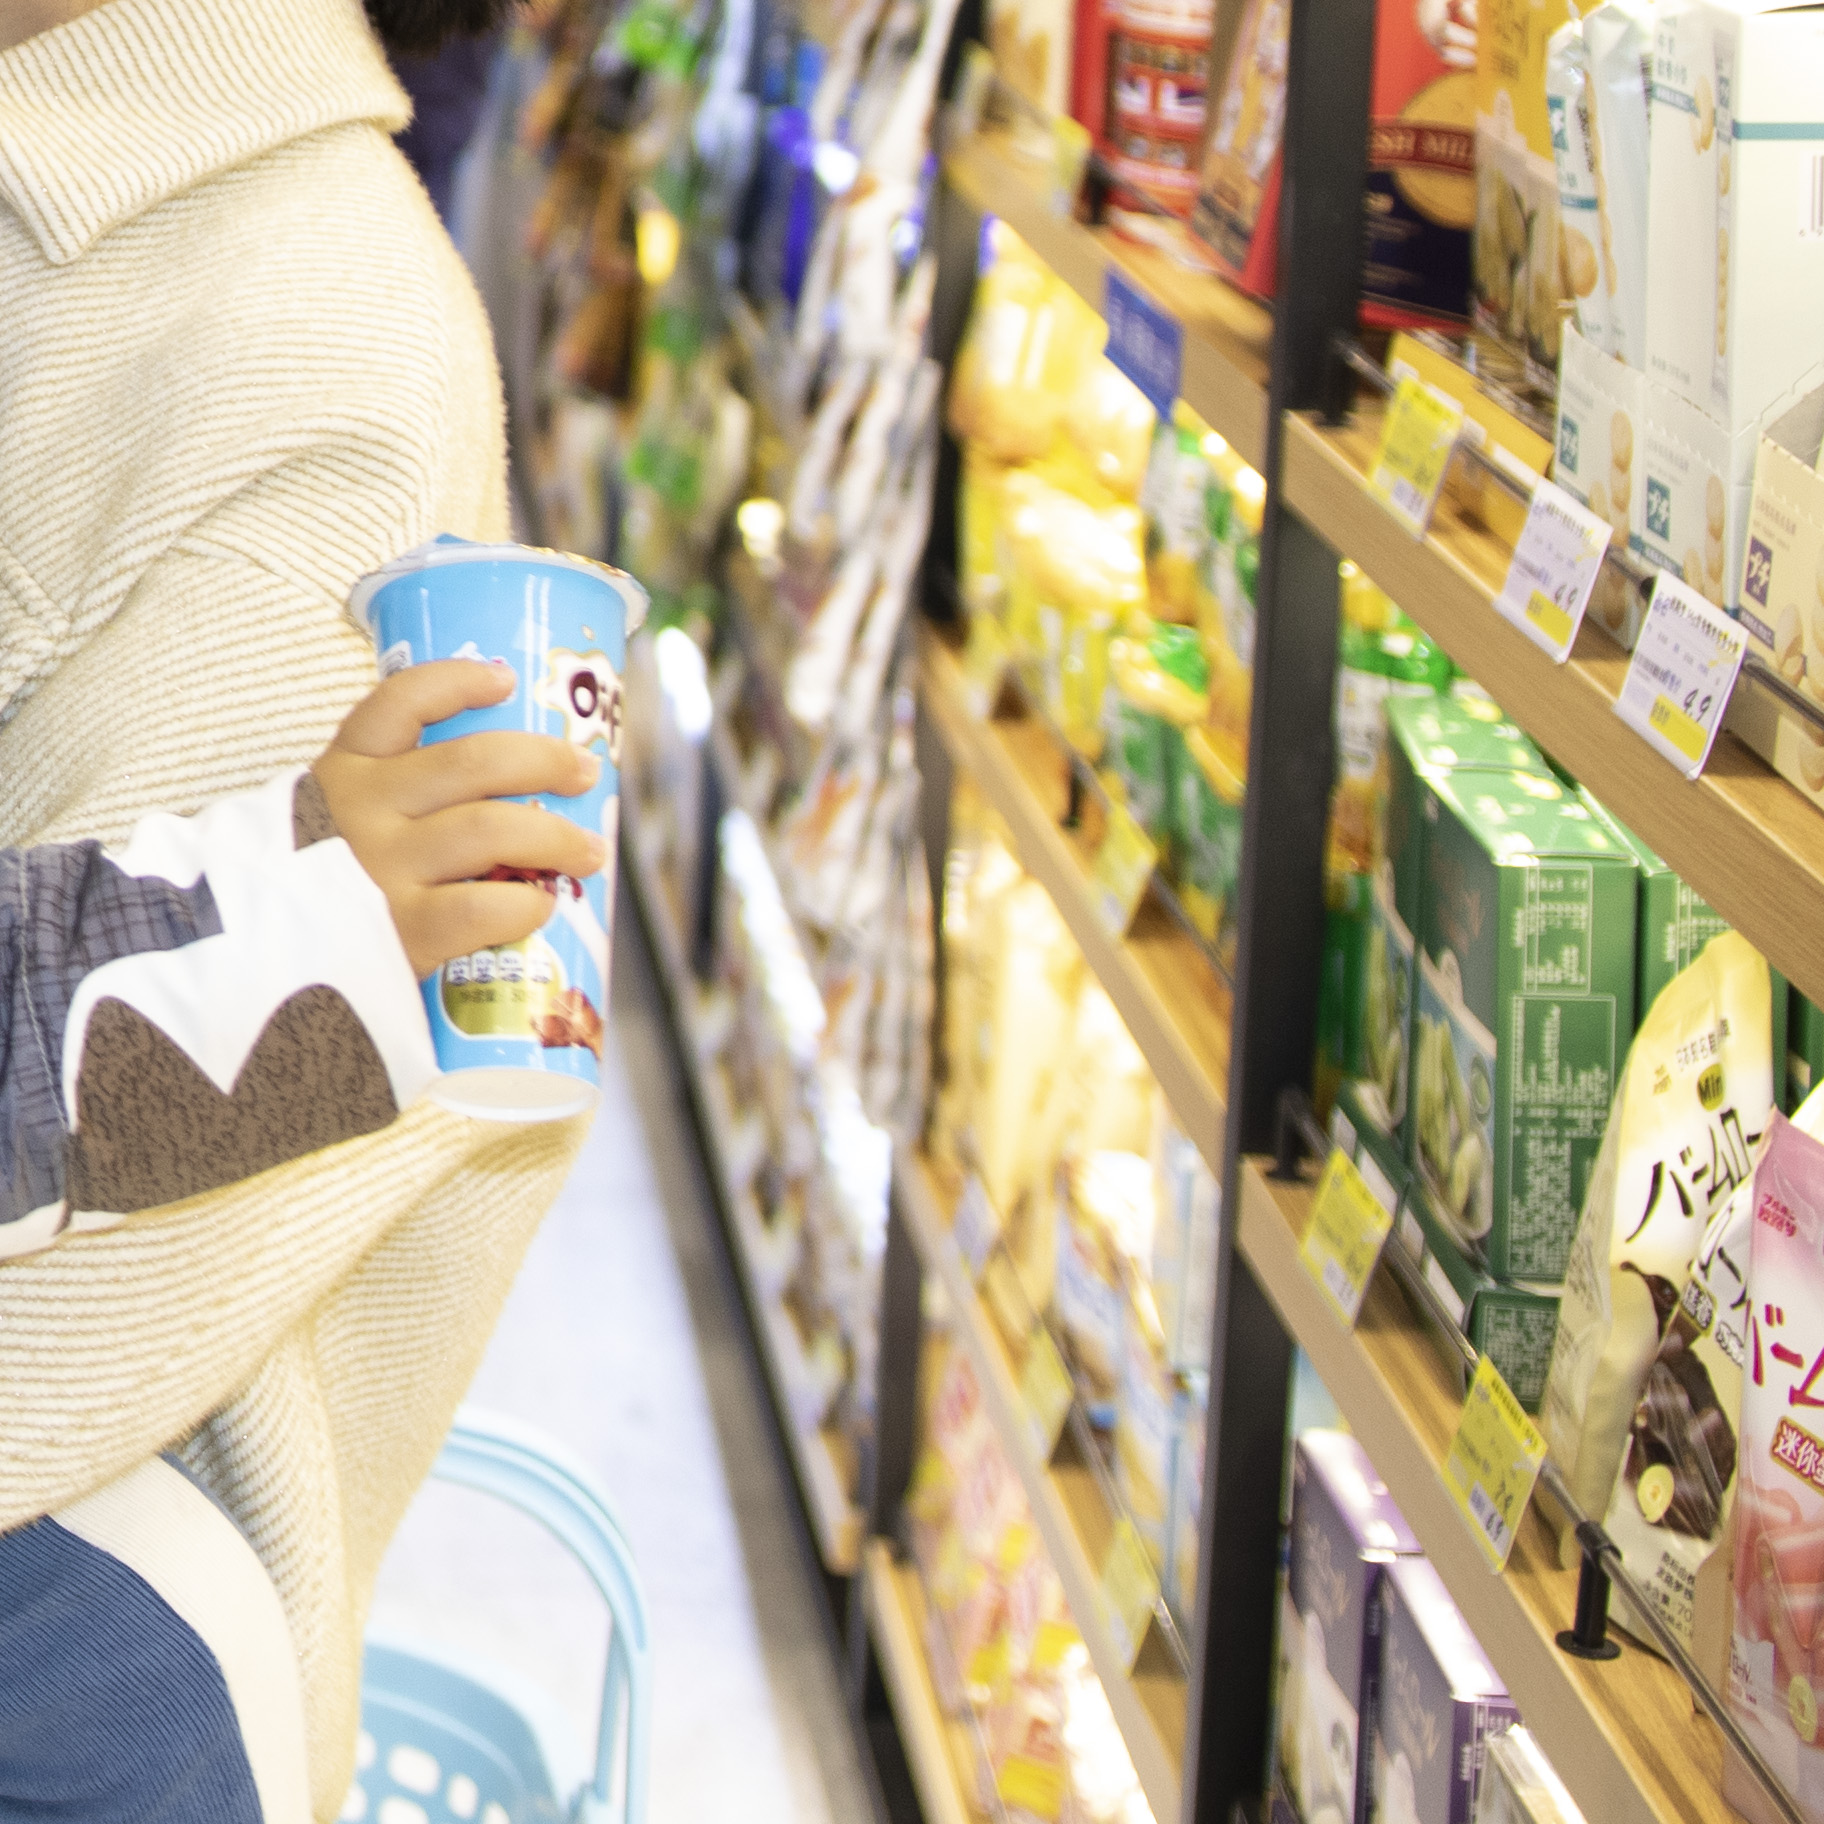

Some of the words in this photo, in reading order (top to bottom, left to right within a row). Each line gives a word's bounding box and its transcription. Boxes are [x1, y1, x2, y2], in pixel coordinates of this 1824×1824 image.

[1682, 687, 1713, 724] 4.9
[1624, 1107, 1764, 1244] バームロー
